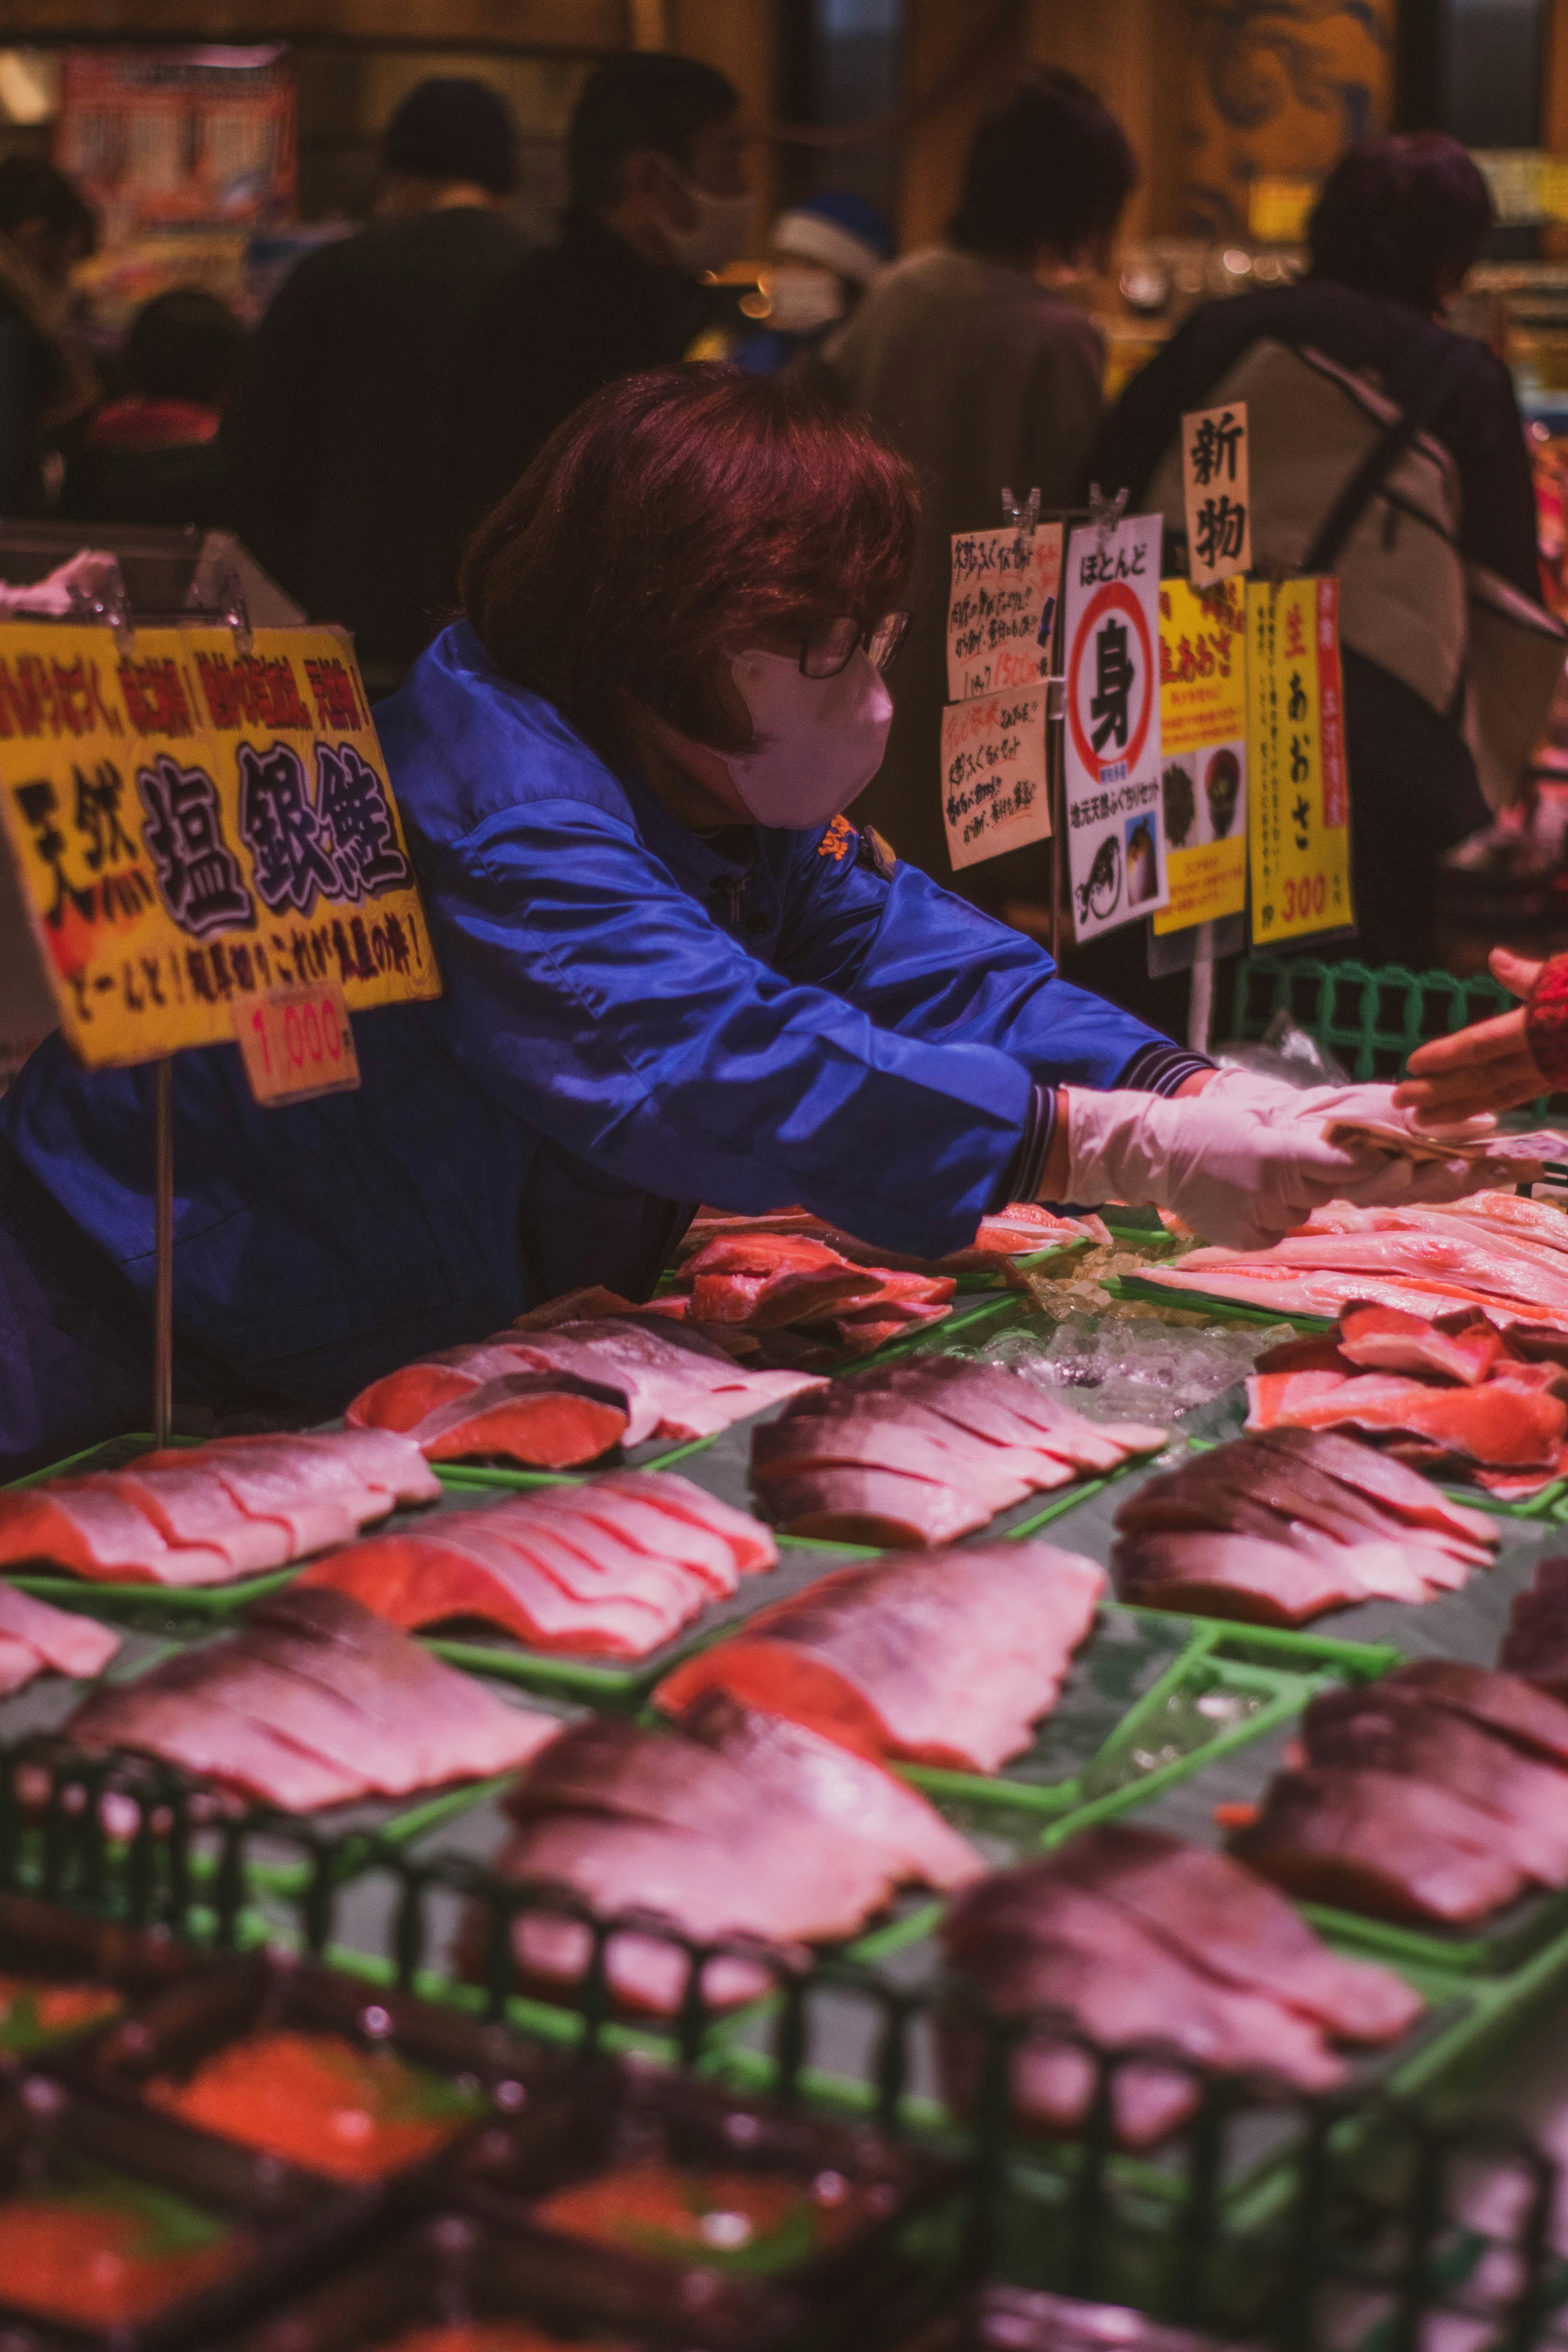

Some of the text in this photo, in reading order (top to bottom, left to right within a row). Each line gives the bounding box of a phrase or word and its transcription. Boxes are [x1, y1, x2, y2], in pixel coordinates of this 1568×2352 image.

[1191, 412, 1246, 569] 新物
[1081, 543, 1148, 587] ほとんど
[1090, 618, 1135, 756] 身
[14, 760, 155, 928] 天然
[1281, 873, 1326, 922] 300
